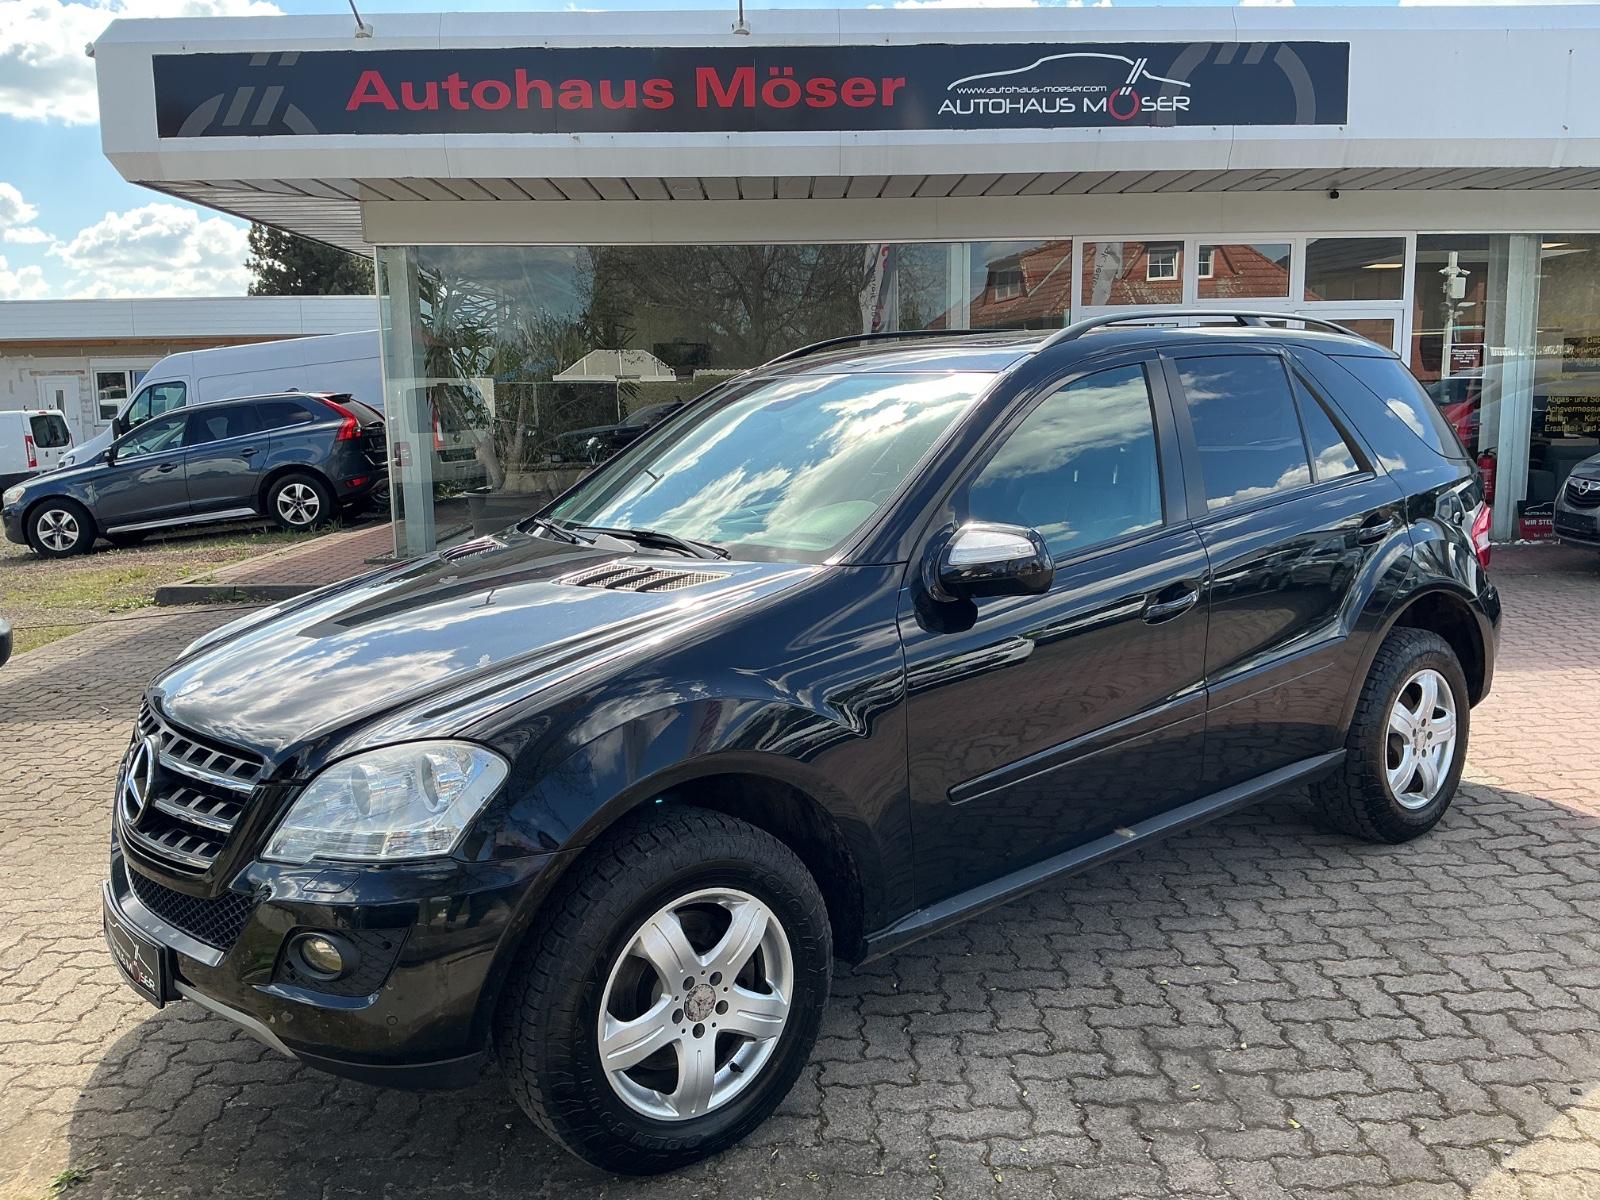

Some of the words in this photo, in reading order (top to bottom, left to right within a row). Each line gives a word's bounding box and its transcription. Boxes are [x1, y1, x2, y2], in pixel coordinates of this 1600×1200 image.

[345, 68, 675, 111] Autohaus
[694, 66, 906, 109] Möser
[937, 97, 1076, 115] AUTOHAUS
[1083, 87, 1191, 121] MÖSER
[957, 84, 1108, 95] www.autohaus-moeser.com
